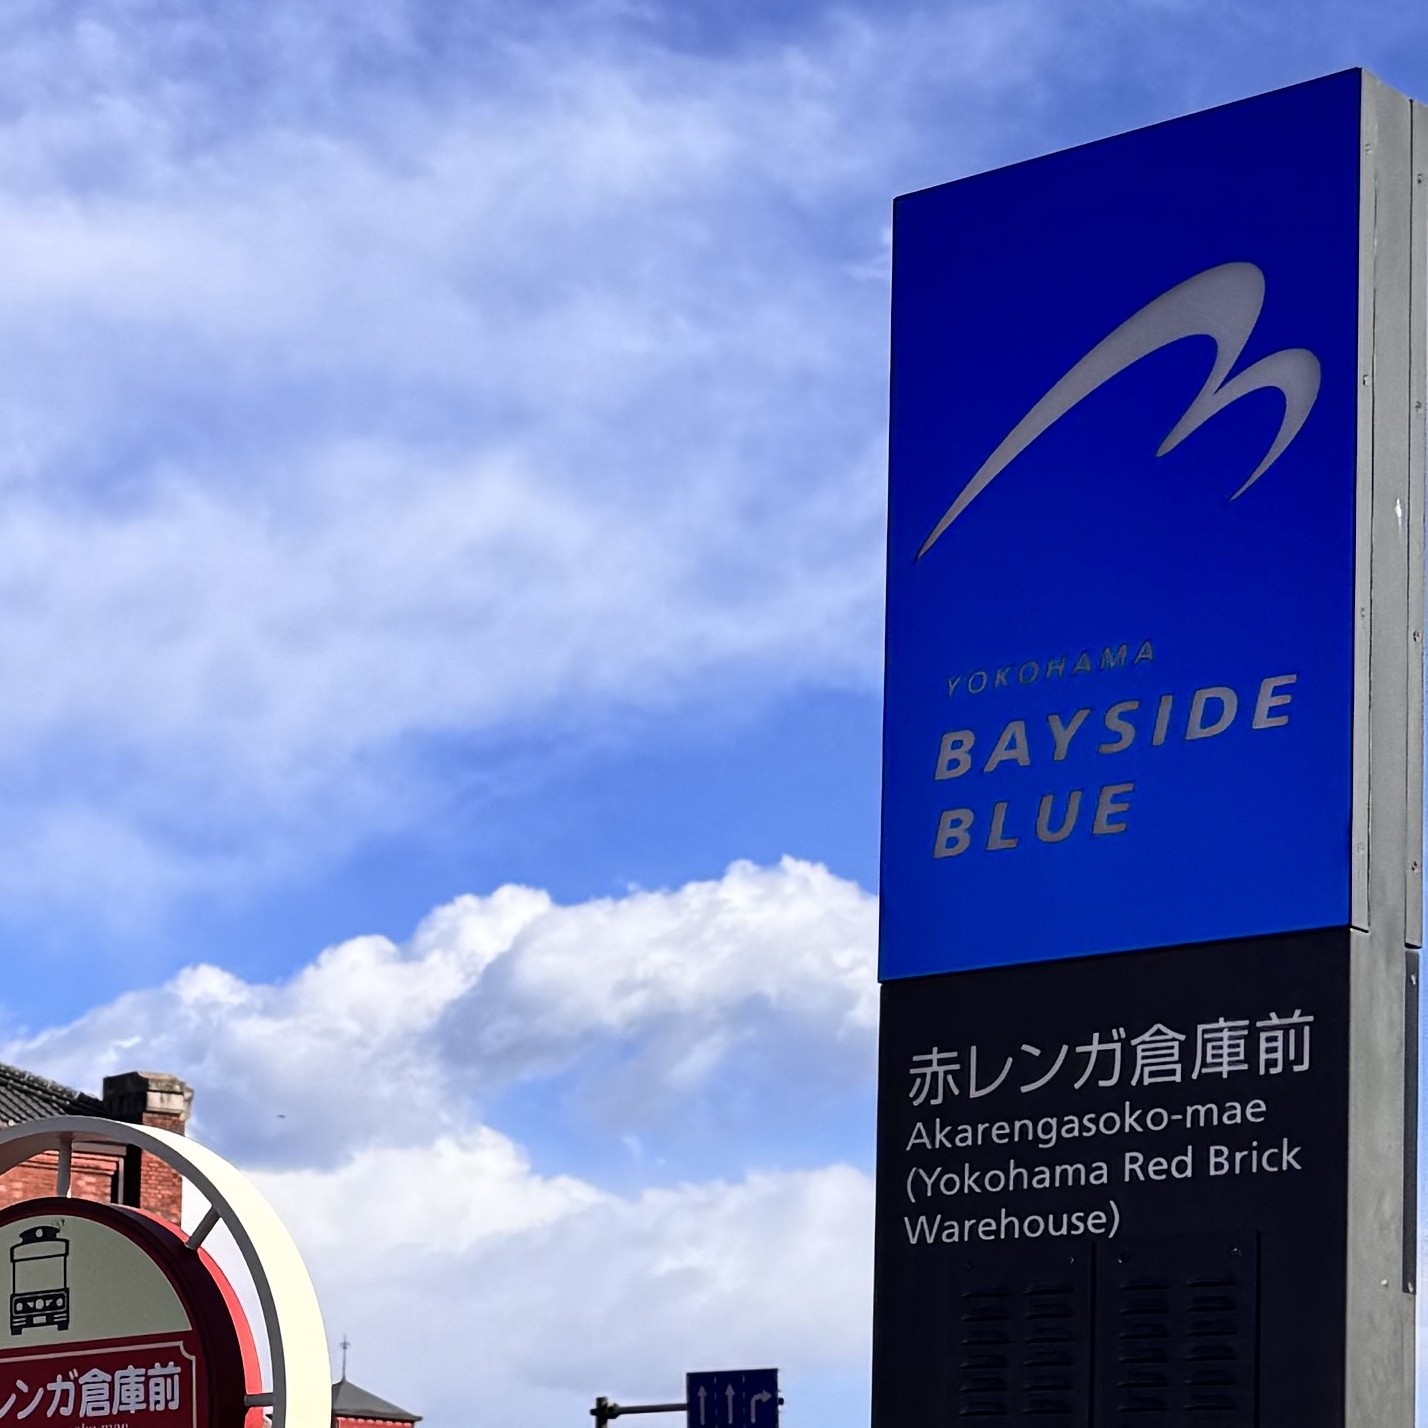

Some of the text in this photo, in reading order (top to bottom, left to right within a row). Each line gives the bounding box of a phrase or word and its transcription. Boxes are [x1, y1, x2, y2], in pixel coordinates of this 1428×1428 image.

[948, 639, 1156, 697] YOKOHAMA
[934, 674, 1298, 781] BAYSIDE
[932, 782, 1135, 859] BLUE
[907, 1009, 1315, 1107] 赤レンガ倉庫前
[905, 1096, 1267, 1152] Akarengasoko-mae
[905, 1139, 1302, 1203] (Yokohama Red Brick
[904, 1200, 1121, 1245] Warehouse)
